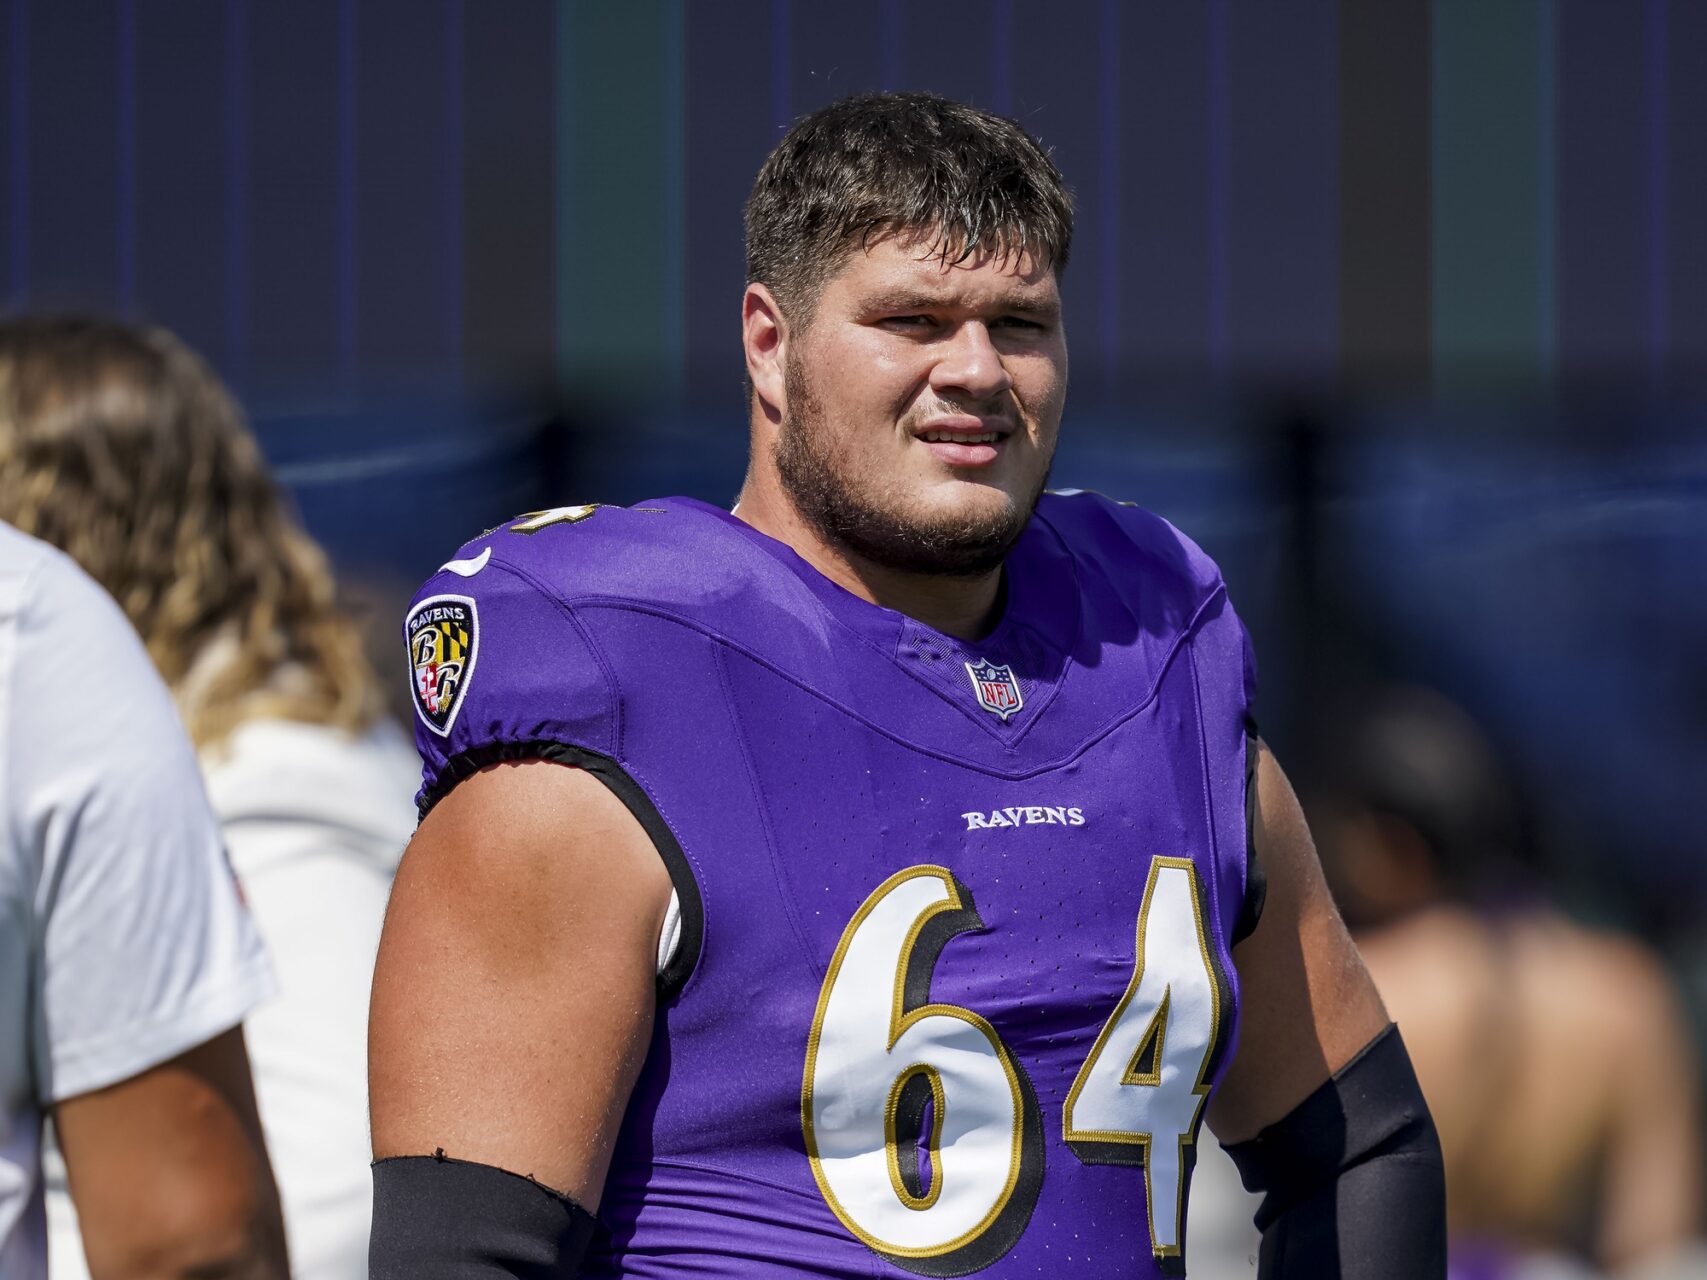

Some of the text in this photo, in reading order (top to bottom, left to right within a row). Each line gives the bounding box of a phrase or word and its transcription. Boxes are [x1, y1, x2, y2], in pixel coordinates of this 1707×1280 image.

[410, 607, 465, 634] RAVENS
[982, 683, 1015, 707] NFL
[961, 806, 1086, 831] RAVENS
[801, 855, 1237, 1278] 64
